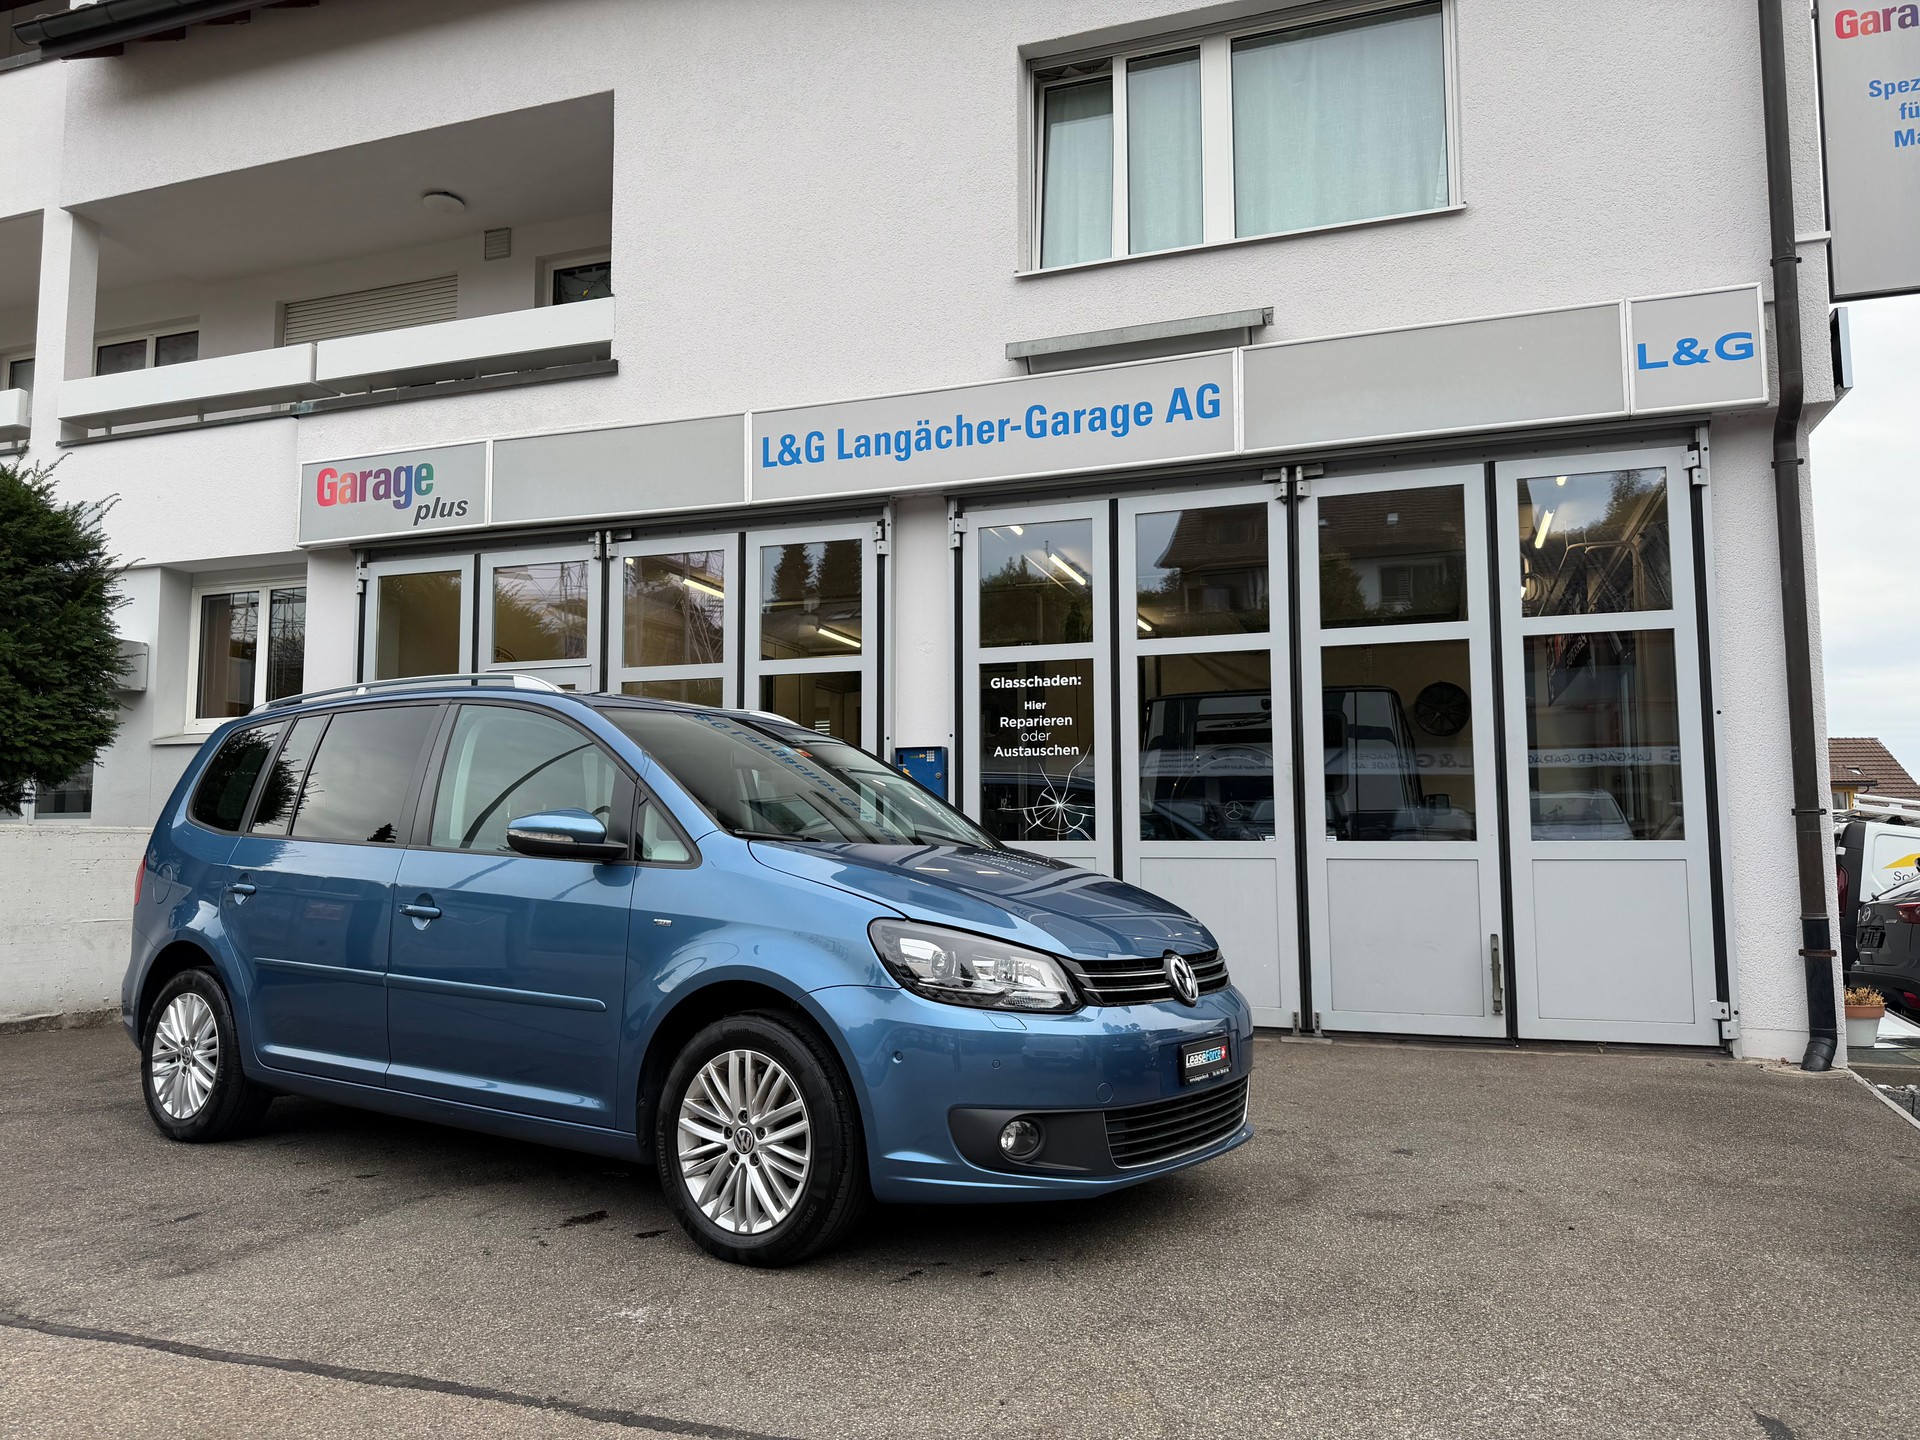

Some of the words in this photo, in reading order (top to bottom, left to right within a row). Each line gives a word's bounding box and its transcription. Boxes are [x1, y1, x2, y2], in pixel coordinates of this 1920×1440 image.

[1834, 3, 1920, 40] Gara
[1868, 78, 1920, 101] Spez
[1637, 331, 1754, 371] L&G
[762, 430, 826, 468] L&G
[837, 401, 1153, 462] Langächer-Garage
[1165, 382, 1220, 424] AG
[316, 462, 434, 510] Garage
[412, 496, 469, 526] plus
[990, 674, 1082, 689] Glasschaden:
[1024, 700, 1047, 710] Hier
[1000, 715, 1073, 729] Reparieren
[1020, 730, 1051, 742] oder
[993, 744, 1079, 758] Austauschen
